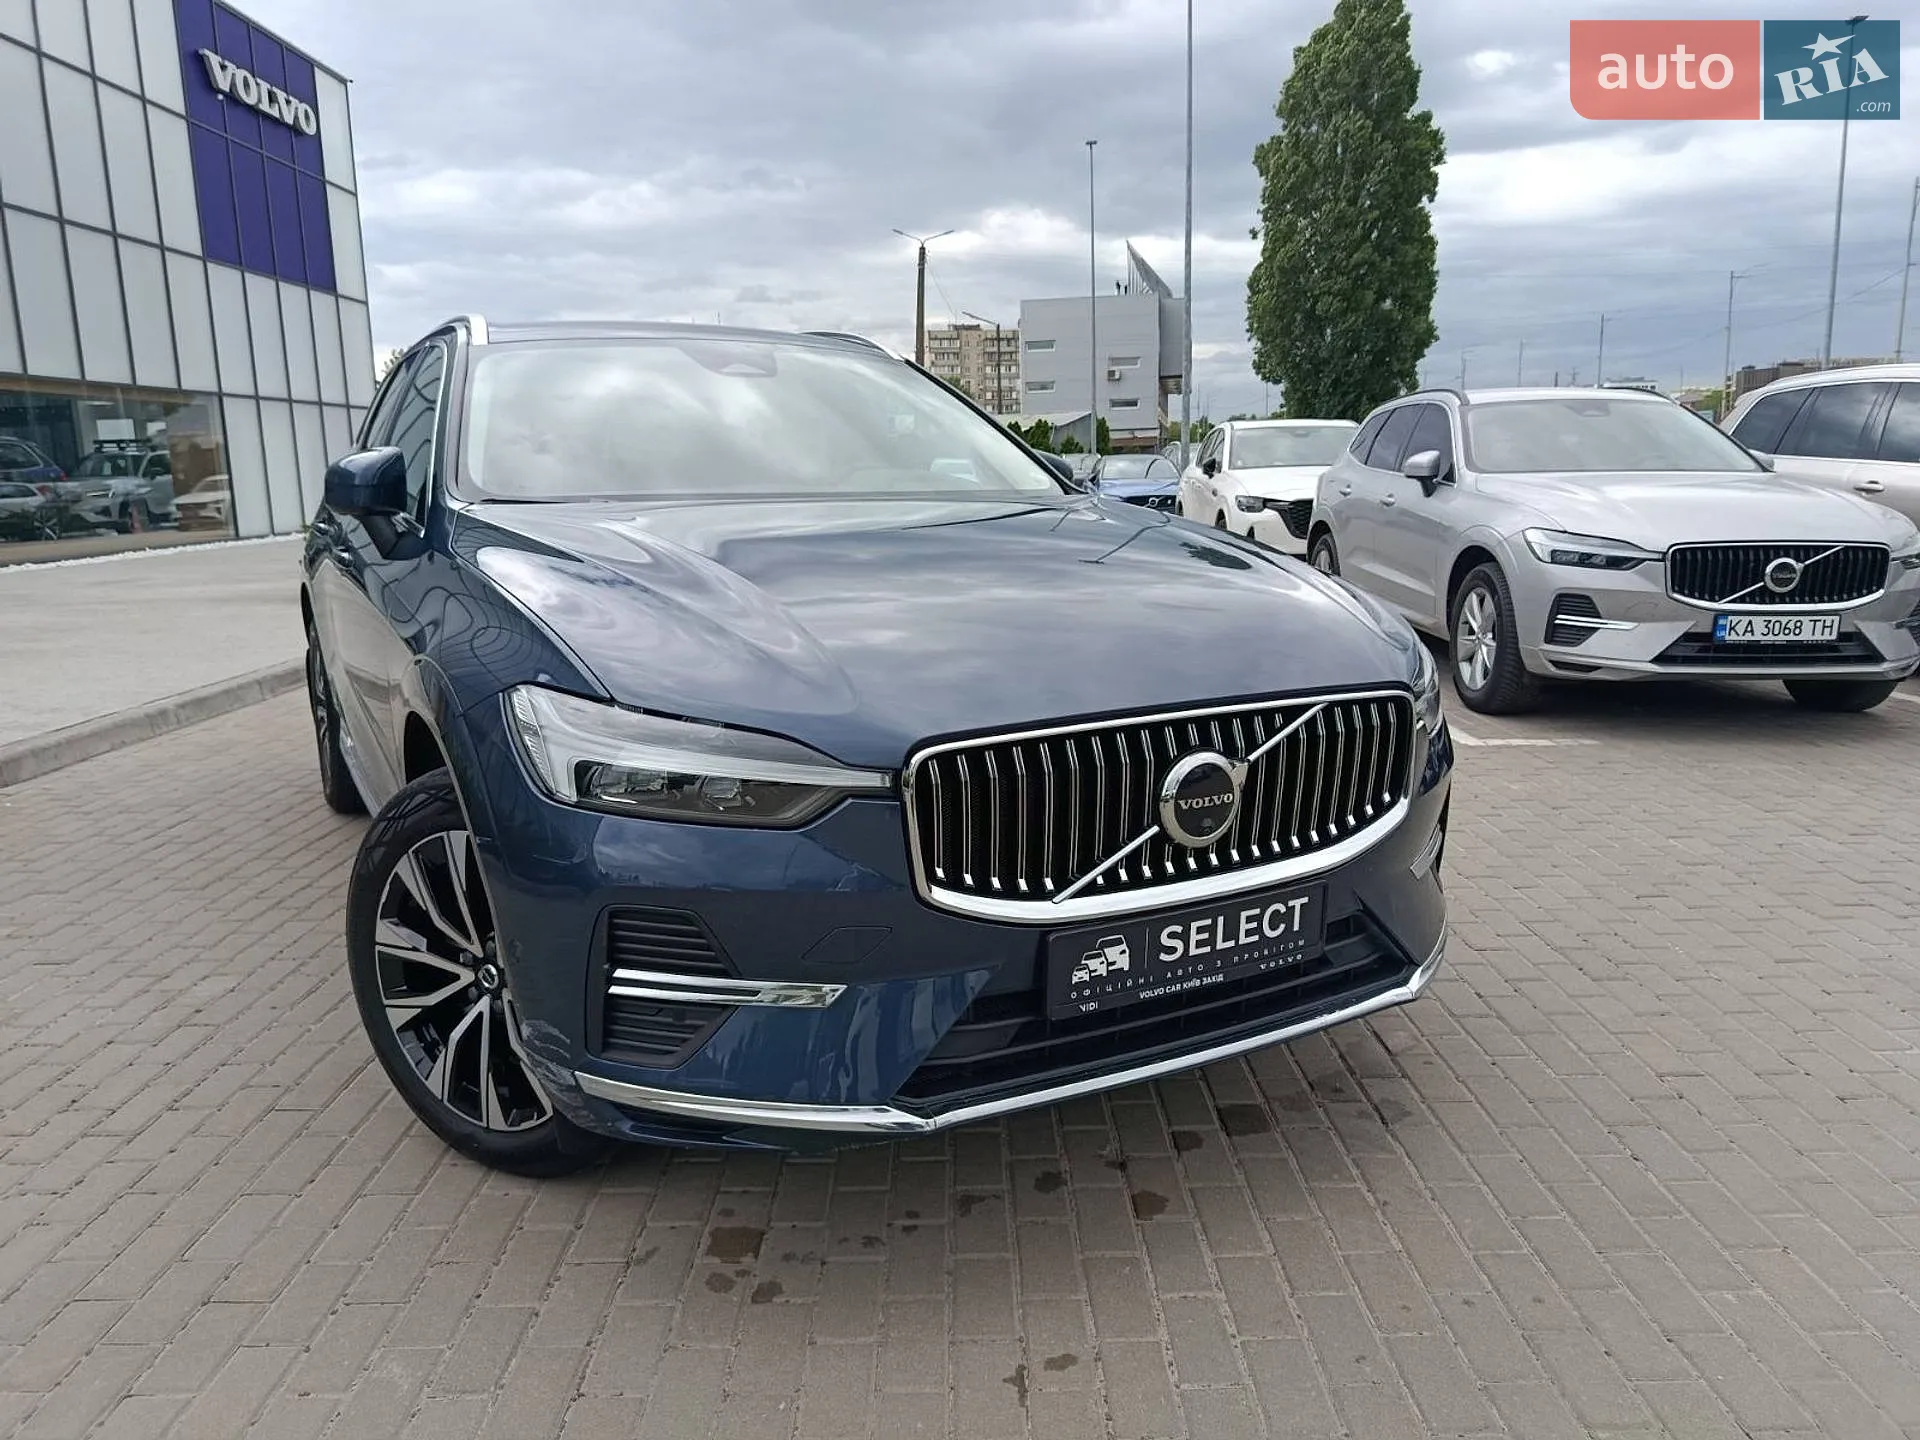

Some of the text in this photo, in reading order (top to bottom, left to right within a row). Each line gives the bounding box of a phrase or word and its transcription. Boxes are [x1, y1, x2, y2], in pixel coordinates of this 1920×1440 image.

[199, 48, 317, 135] VOLVO
[1728, 619, 1754, 636] KA
[1761, 619, 1803, 636] 3068
[1810, 619, 1835, 636] TH
[1177, 793, 1233, 810] VOLVO
[1159, 896, 1309, 962] SELECT
[1259, 954, 1303, 970] VOLVO
[1139, 986, 1164, 999] VOLVO
[1166, 983, 1181, 994] CAR
[1079, 1001, 1098, 1012] VIDI
